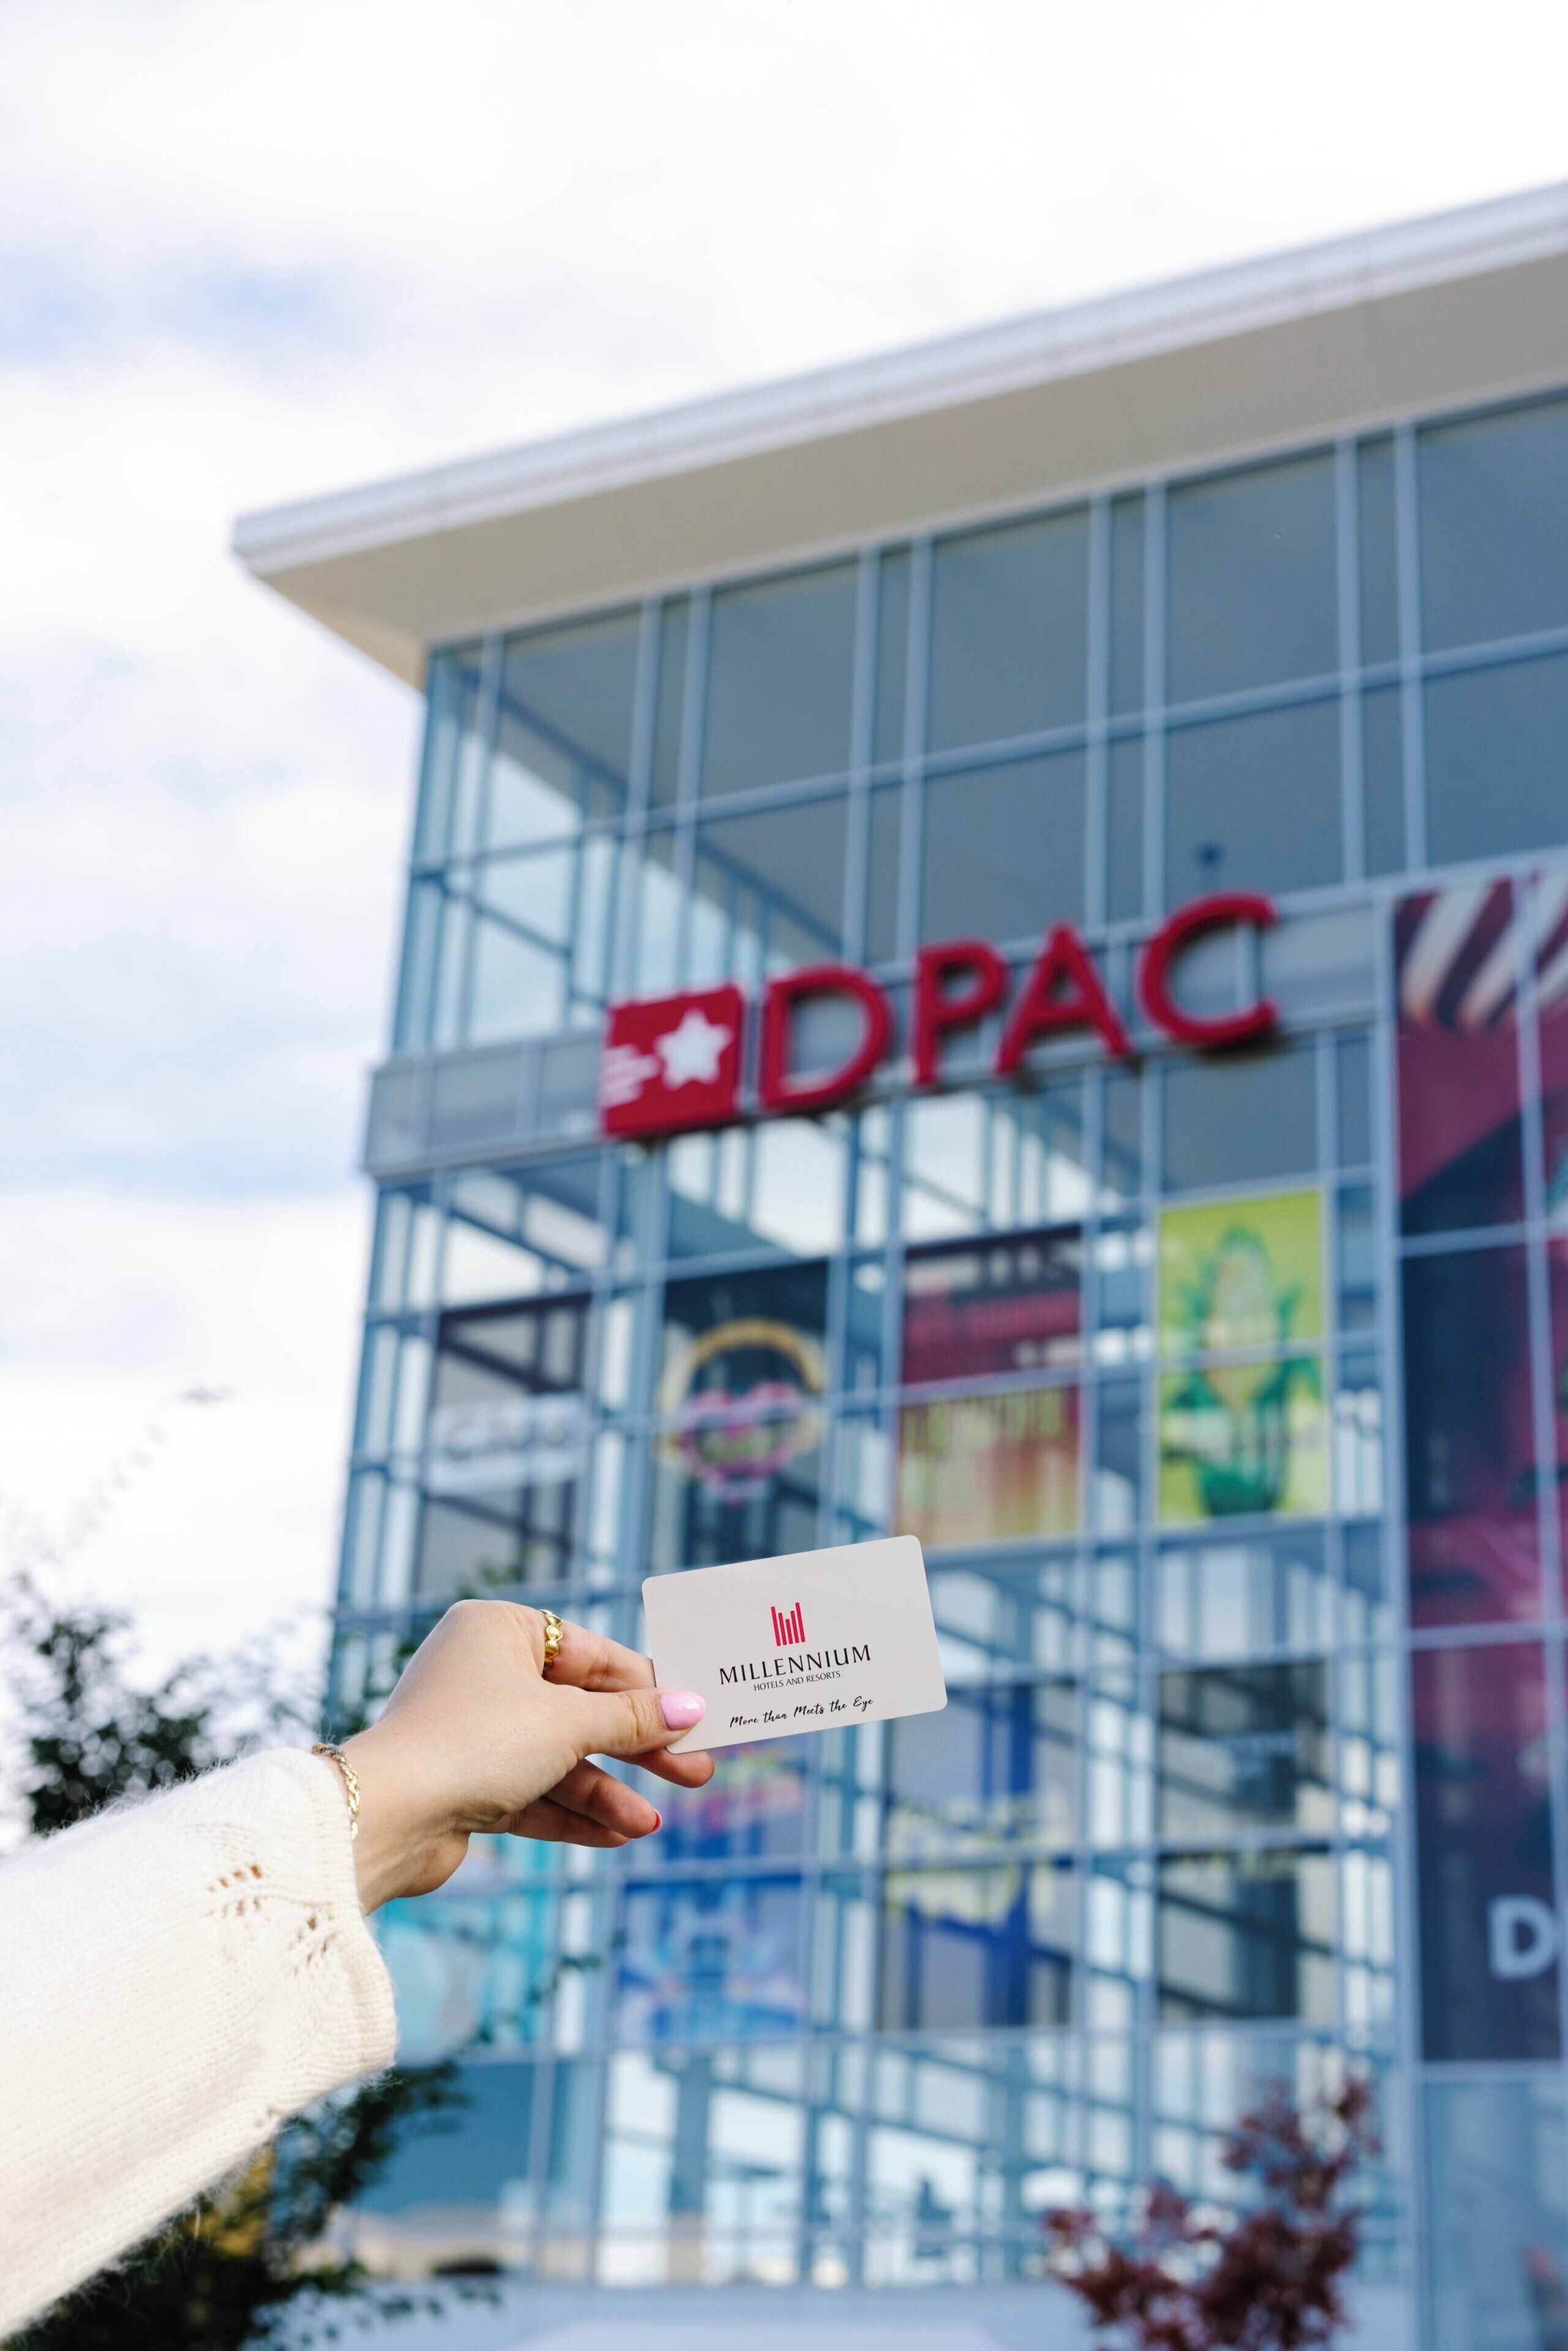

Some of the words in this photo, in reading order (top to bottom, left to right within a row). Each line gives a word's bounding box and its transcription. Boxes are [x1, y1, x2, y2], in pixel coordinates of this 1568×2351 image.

[759, 892, 1275, 1112] DPAC
[719, 1644, 871, 1685] MILLENNIUM
[753, 1679, 784, 1692] HOTELS
[786, 1676, 804, 1686] AND
[806, 1670, 841, 1684] RESORTS
[730, 1715, 759, 1728] More
[762, 1710, 788, 1723] than
[793, 1703, 824, 1718] Meets
[828, 1699, 847, 1712] the
[853, 1695, 873, 1712] Eye
